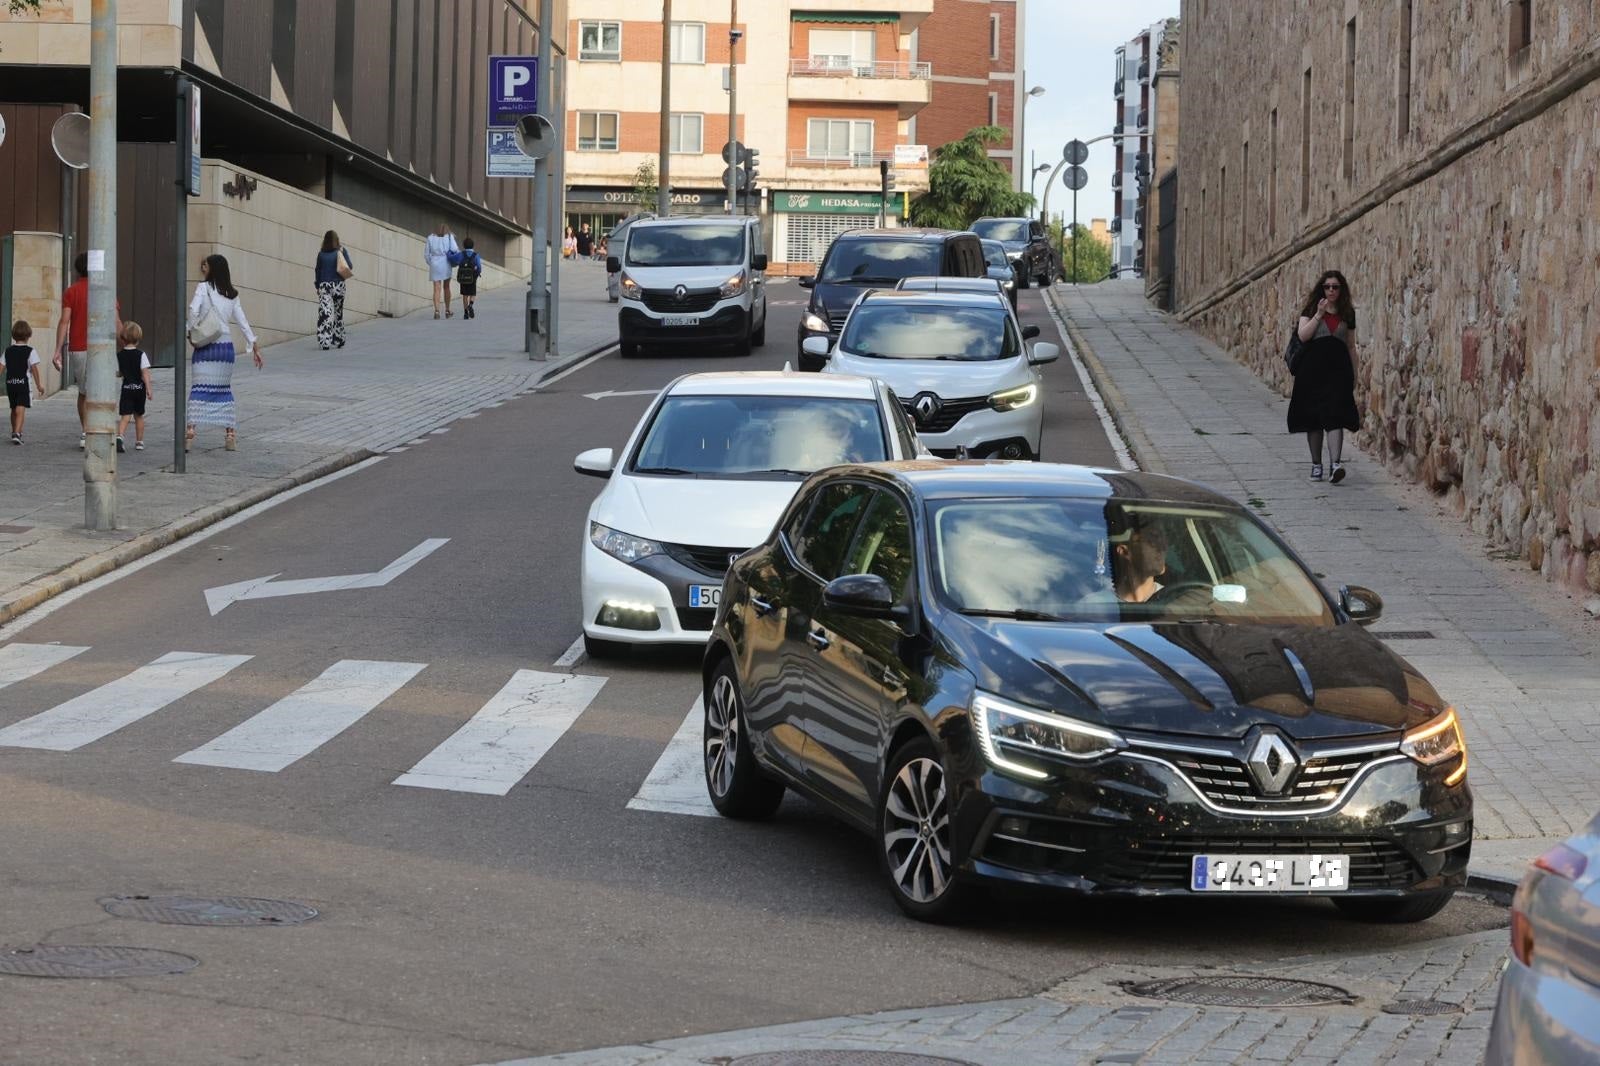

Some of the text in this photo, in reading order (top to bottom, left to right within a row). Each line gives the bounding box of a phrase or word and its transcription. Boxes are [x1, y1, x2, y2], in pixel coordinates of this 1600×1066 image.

[504, 65, 530, 97] P
[492, 133, 504, 146] P
[604, 191, 640, 203] OPTIC
[821, 198, 860, 208] HEDASA
